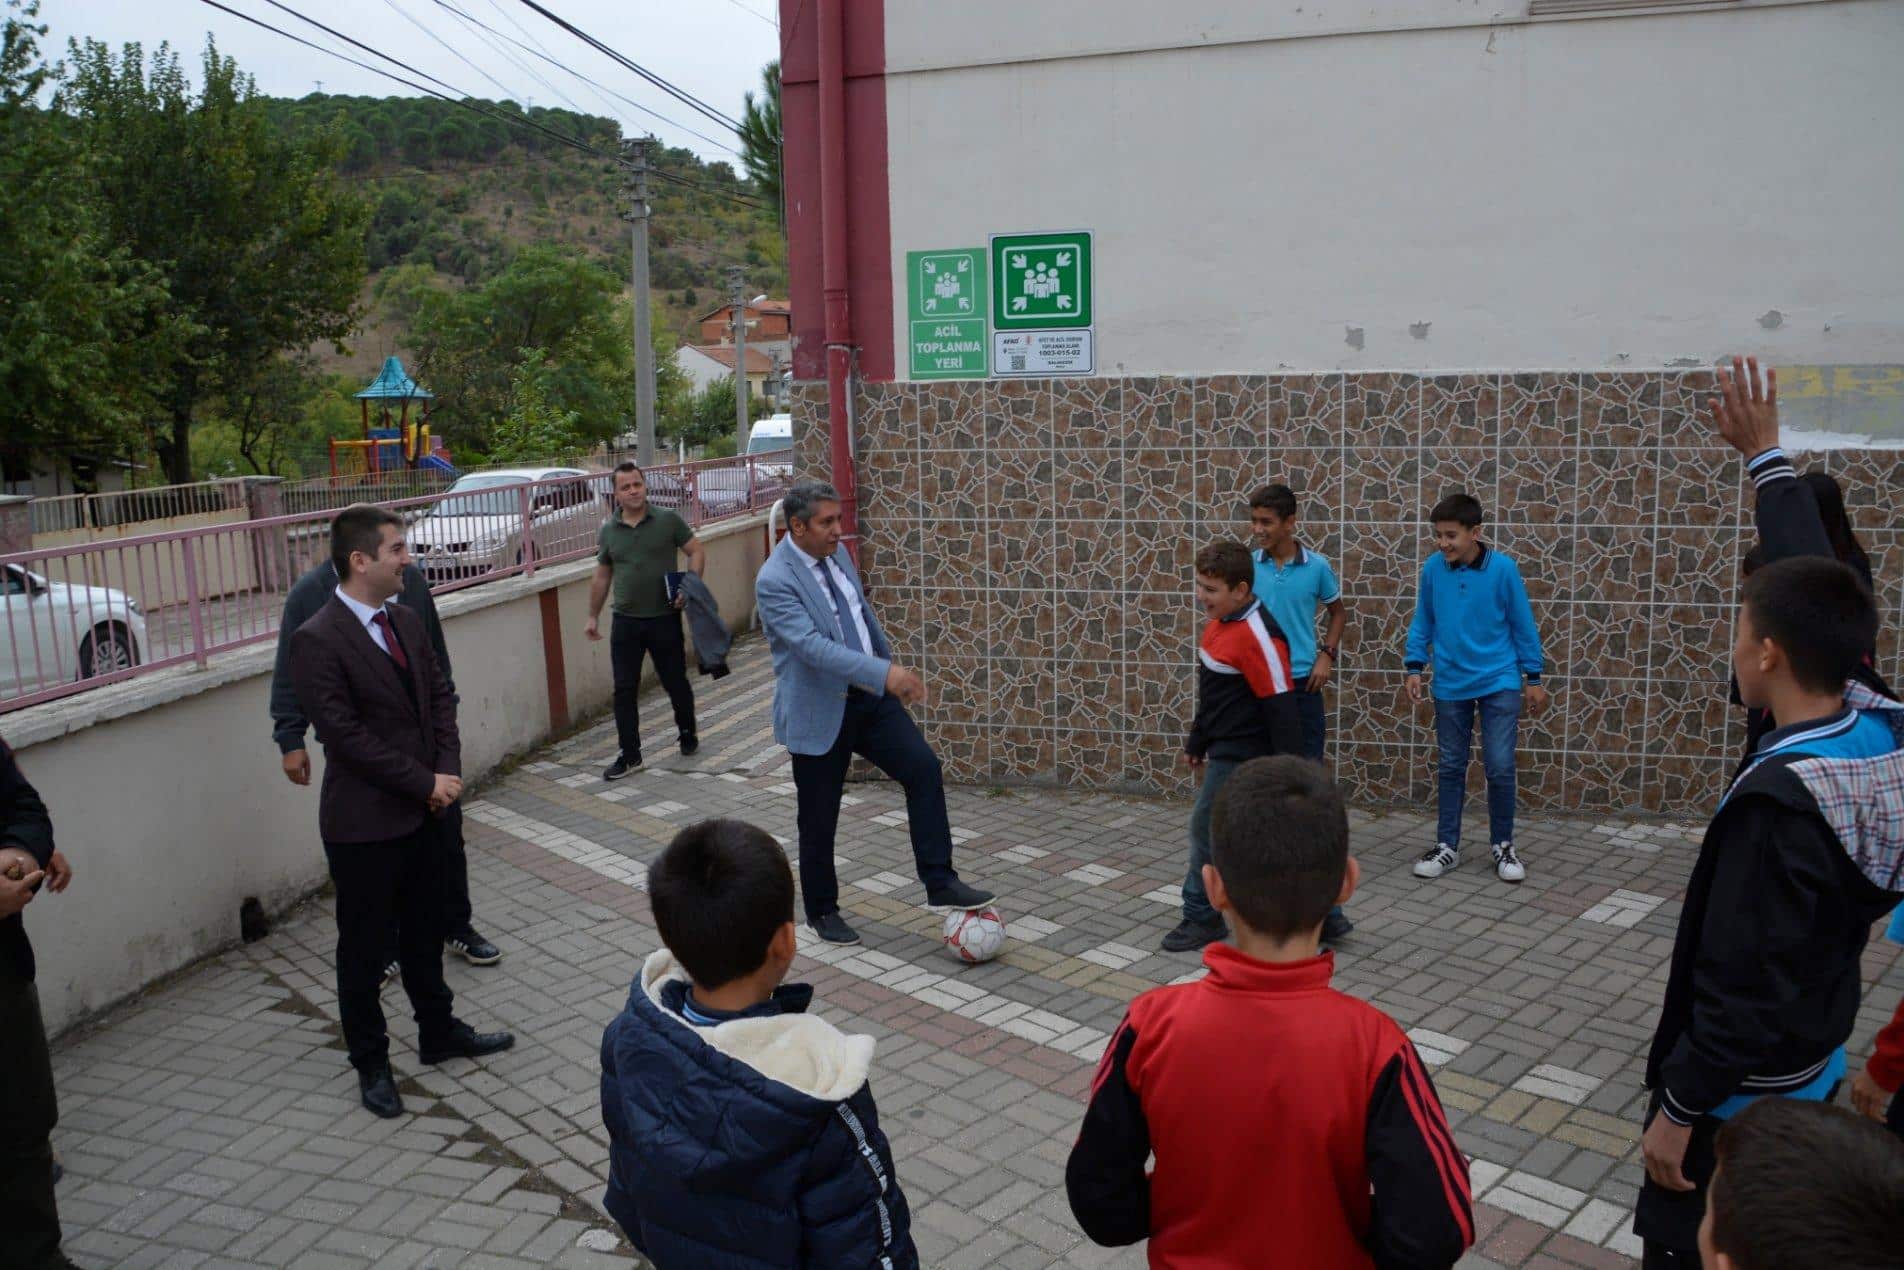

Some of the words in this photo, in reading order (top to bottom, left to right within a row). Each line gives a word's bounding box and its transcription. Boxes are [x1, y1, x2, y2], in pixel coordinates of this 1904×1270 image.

[934, 323, 962, 337] ACİL
[916, 341, 981, 354] TOPLANMA
[935, 354, 963, 369] YERİ
